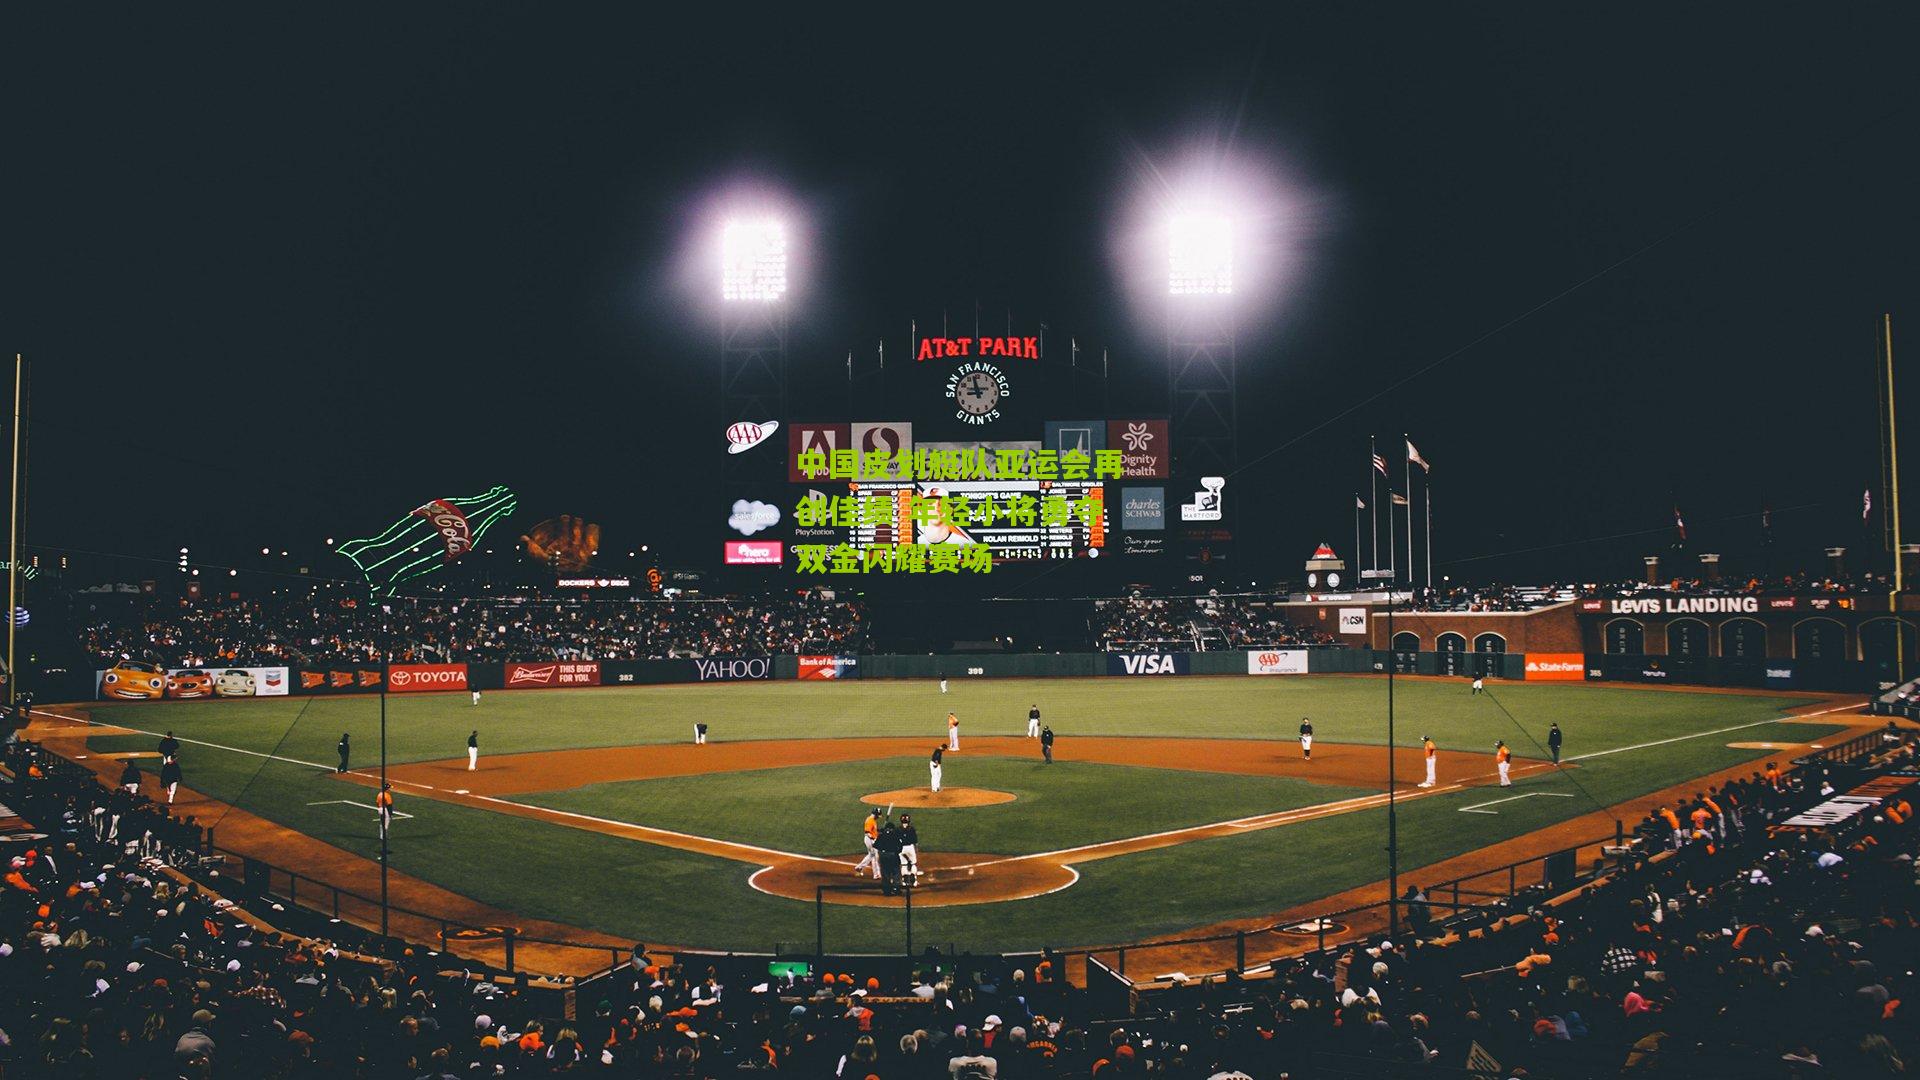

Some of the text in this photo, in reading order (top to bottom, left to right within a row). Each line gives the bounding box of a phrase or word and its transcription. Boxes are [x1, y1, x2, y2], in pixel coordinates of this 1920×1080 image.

[917, 337, 1038, 361] AT&T PARK
[945, 361, 1010, 398] SAN FRANCISCO
[956, 409, 1001, 425] GIANTS
[1120, 454, 1157, 466] Dignity
[1121, 466, 1156, 476] Health
[1125, 499, 1161, 509] charles
[734, 511, 775, 522] salesforce
[1125, 510, 1161, 518] SCHWAB
[795, 528, 835, 537] PlayStation
[1124, 536, 1162, 548] Own your
[558, 579, 630, 587] DOCKERS DECK
[1666, 597, 1759, 614] LANDING
[1349, 616, 1364, 625] CSN
[800, 658, 818, 666] Bank
[827, 658, 856, 666] America
[1119, 654, 1176, 674] VISA
[559, 664, 598, 674] THIS BUD'S
[695, 658, 770, 680] YAHOO!
[413, 671, 466, 683] TOYOTA
[515, 670, 551, 679] Budweiser
[559, 673, 590, 683] FOR YOU.
